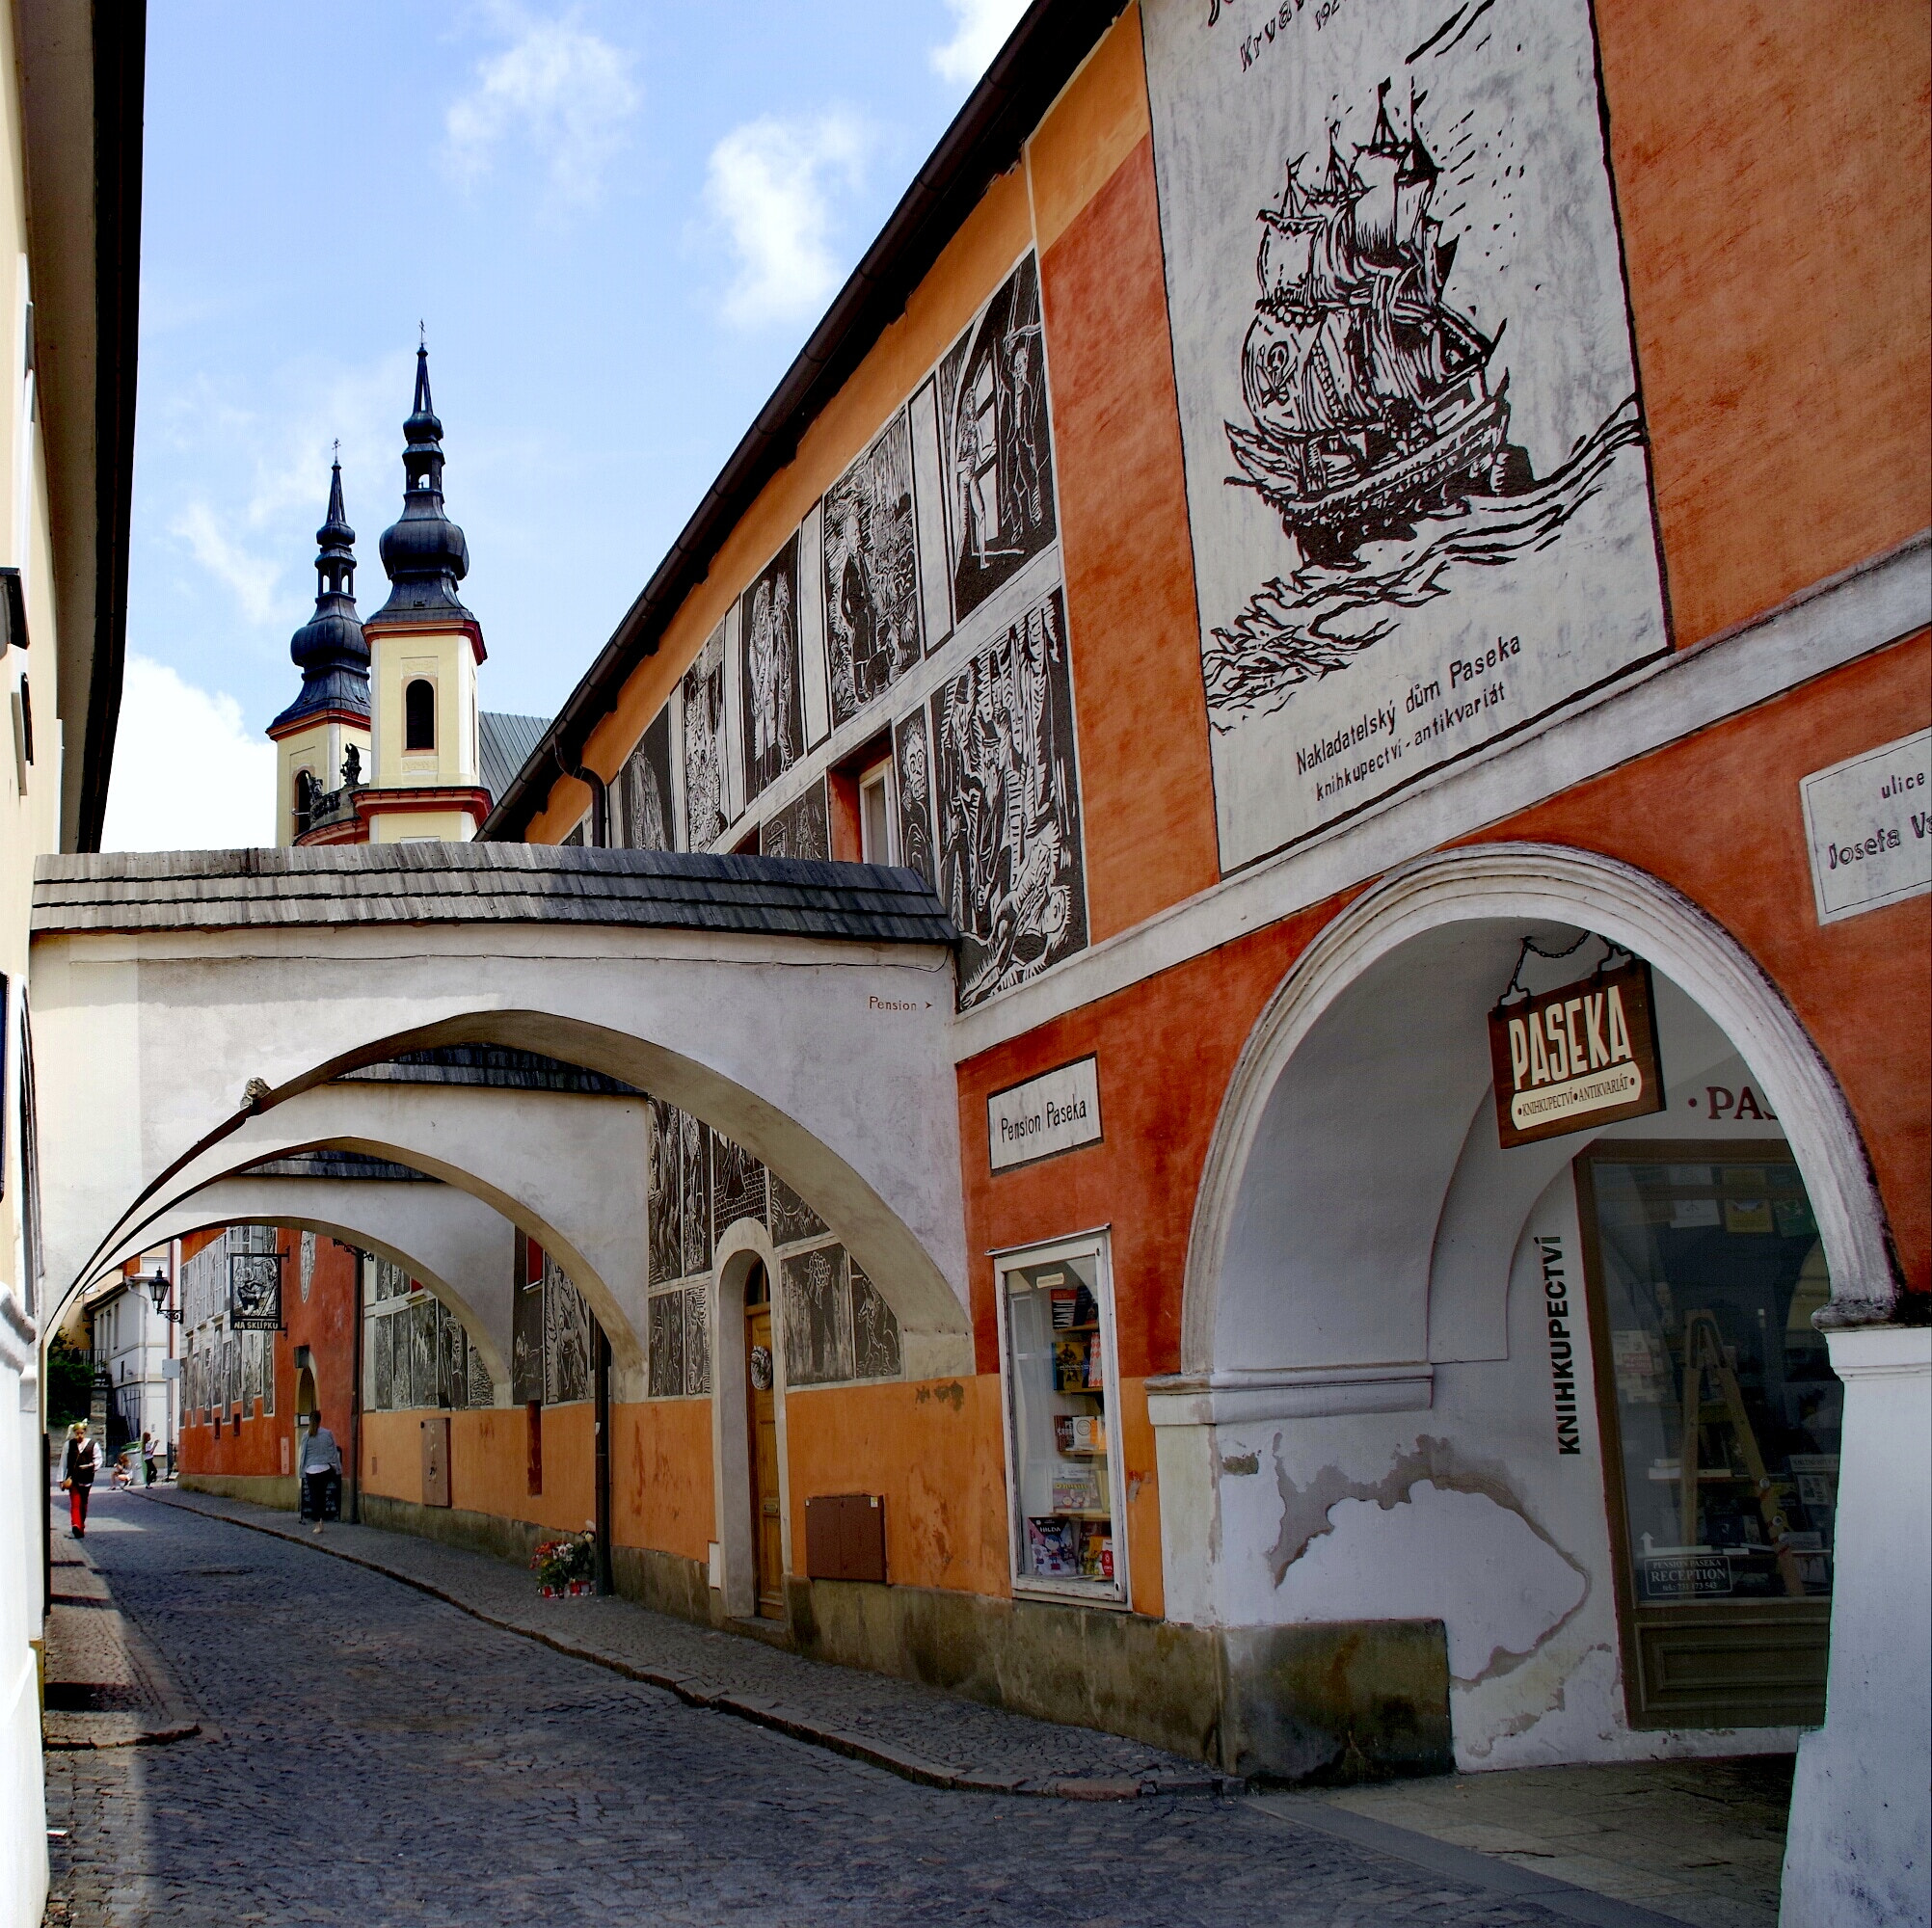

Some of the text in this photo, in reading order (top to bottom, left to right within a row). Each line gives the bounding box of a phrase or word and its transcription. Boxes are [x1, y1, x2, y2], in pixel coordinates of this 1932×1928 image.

[1296, 635, 1521, 776] Nakladatelský dům Paseka
[1316, 741, 1403, 802] knihkupectví
[1414, 682, 1506, 748] antikvariát
[1881, 772, 1925, 799] ulice
[1828, 828, 1901, 870] Josefa
[869, 996, 917, 1011] Pension
[1508, 985, 1632, 1090] PASEKA
[1522, 1073, 1628, 1117] KNIHKUPECTVÍ ANTIKVARIÁT
[1001, 1093, 1087, 1143] Pension Paseka
[233, 1321, 246, 1329] NA
[1533, 1236, 1581, 1456] KNIHKUPECTVÍ
[1650, 1568, 1726, 1582] RECEPTION
[1689, 1559, 1722, 1567] PASEKA
